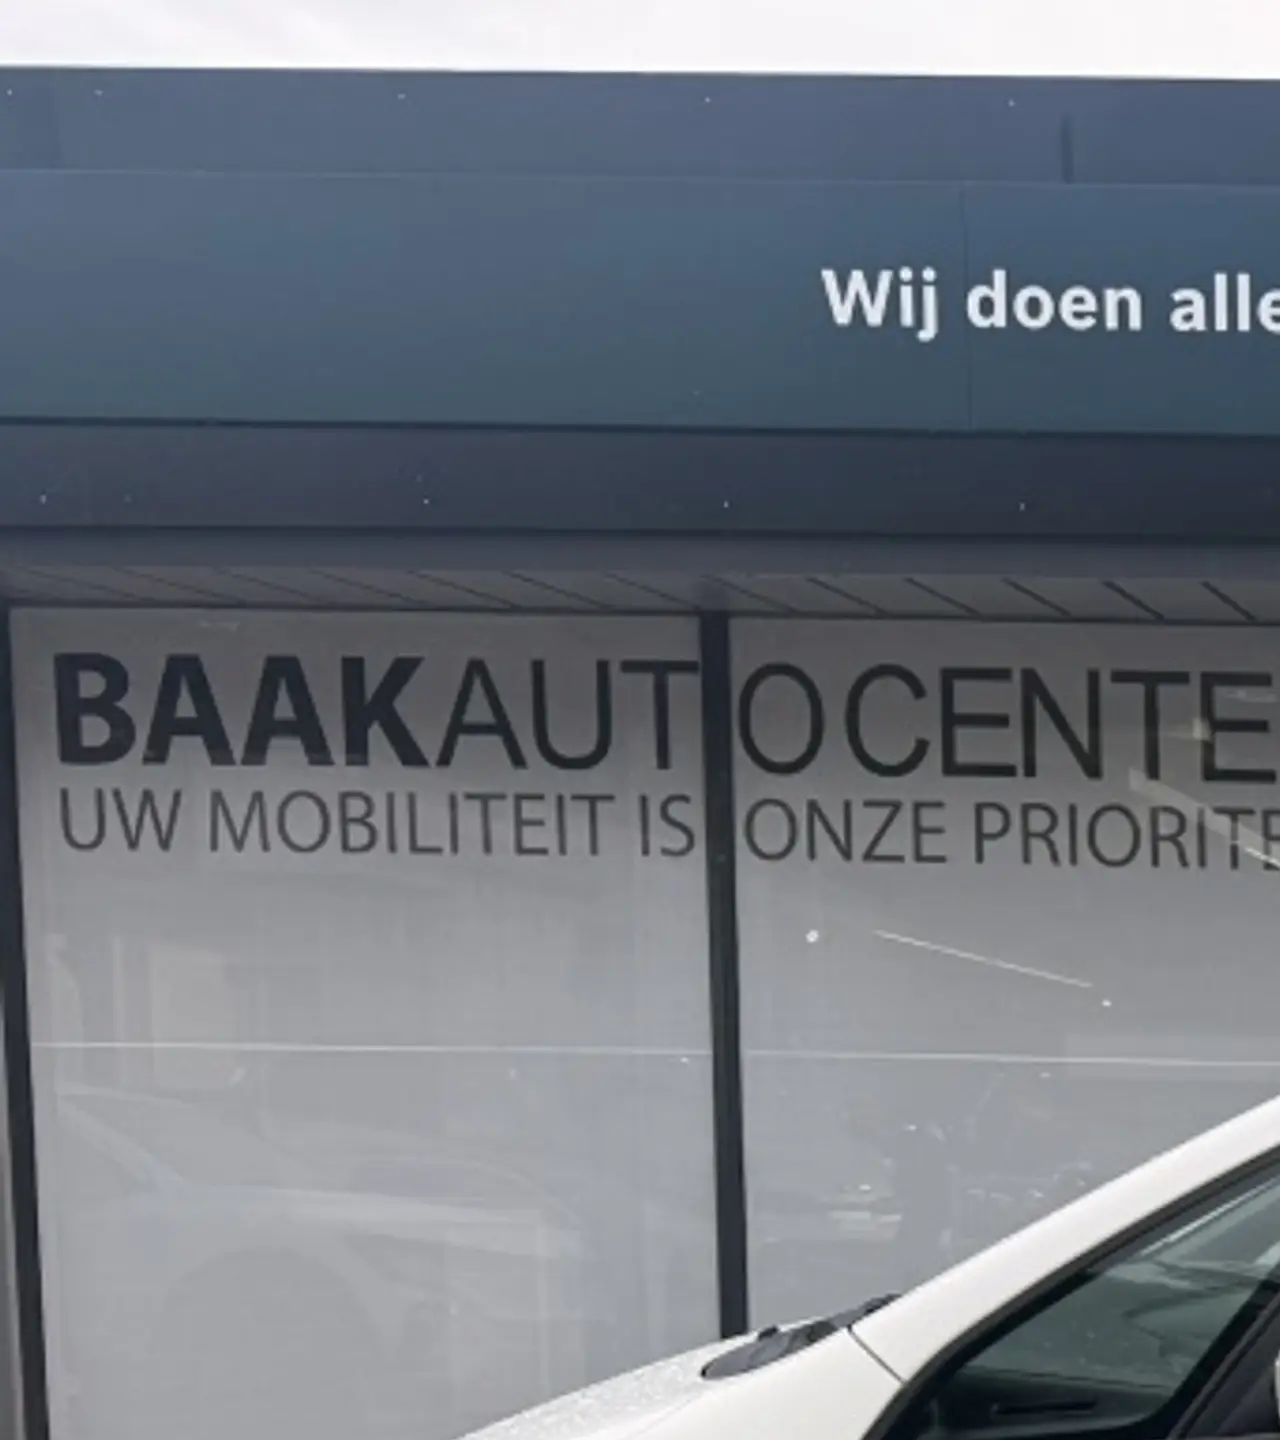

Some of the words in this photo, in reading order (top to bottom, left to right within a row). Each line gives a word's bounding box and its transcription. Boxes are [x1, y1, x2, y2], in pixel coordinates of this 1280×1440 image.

[821, 267, 940, 343] Wij
[966, 269, 1142, 333] doen
[60, 788, 182, 852] UW
[208, 791, 614, 857] MOBILITEIT
[639, 795, 696, 857] IS
[744, 799, 946, 864] ONZE
